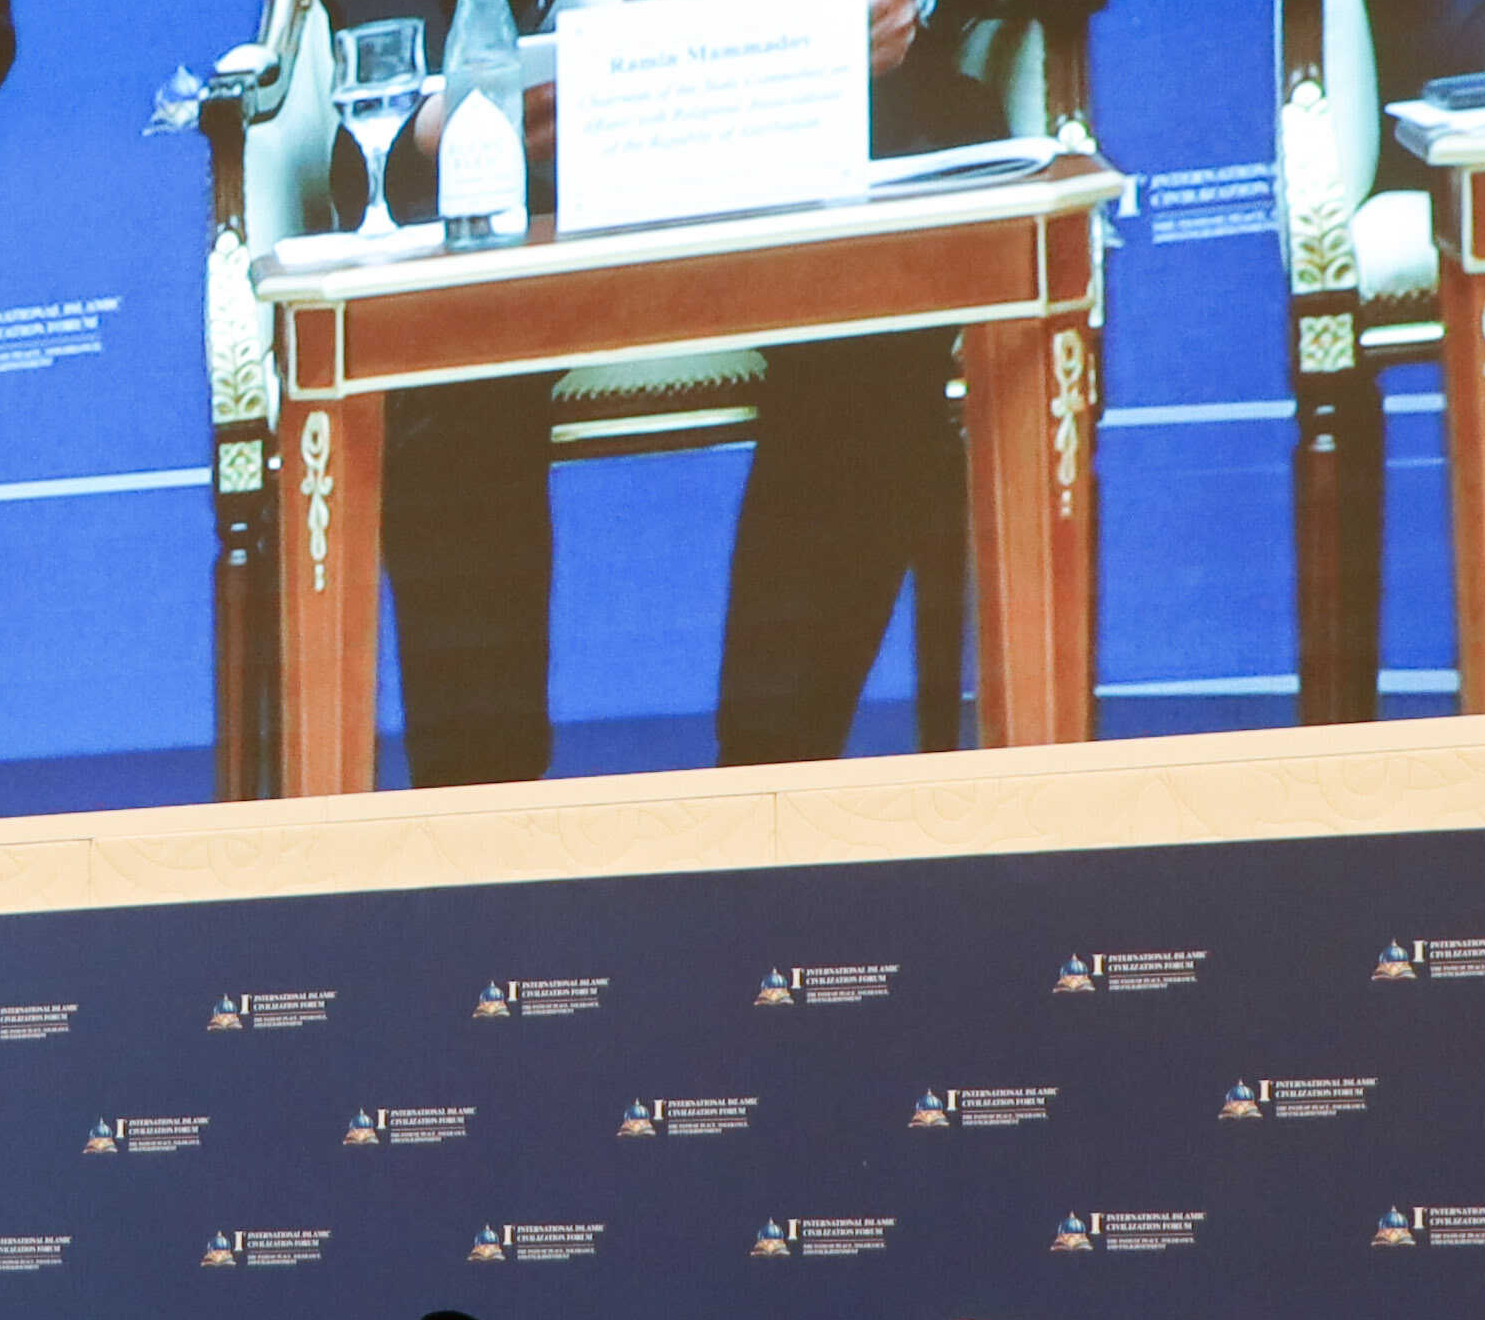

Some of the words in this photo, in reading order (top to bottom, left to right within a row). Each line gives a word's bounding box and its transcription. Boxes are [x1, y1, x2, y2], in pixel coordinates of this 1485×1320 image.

[1108, 953, 1172, 962] INTERNATIONAL
[1174, 951, 1207, 959] ISLAMIC
[1107, 963, 1162, 972] CIVILIZATION
